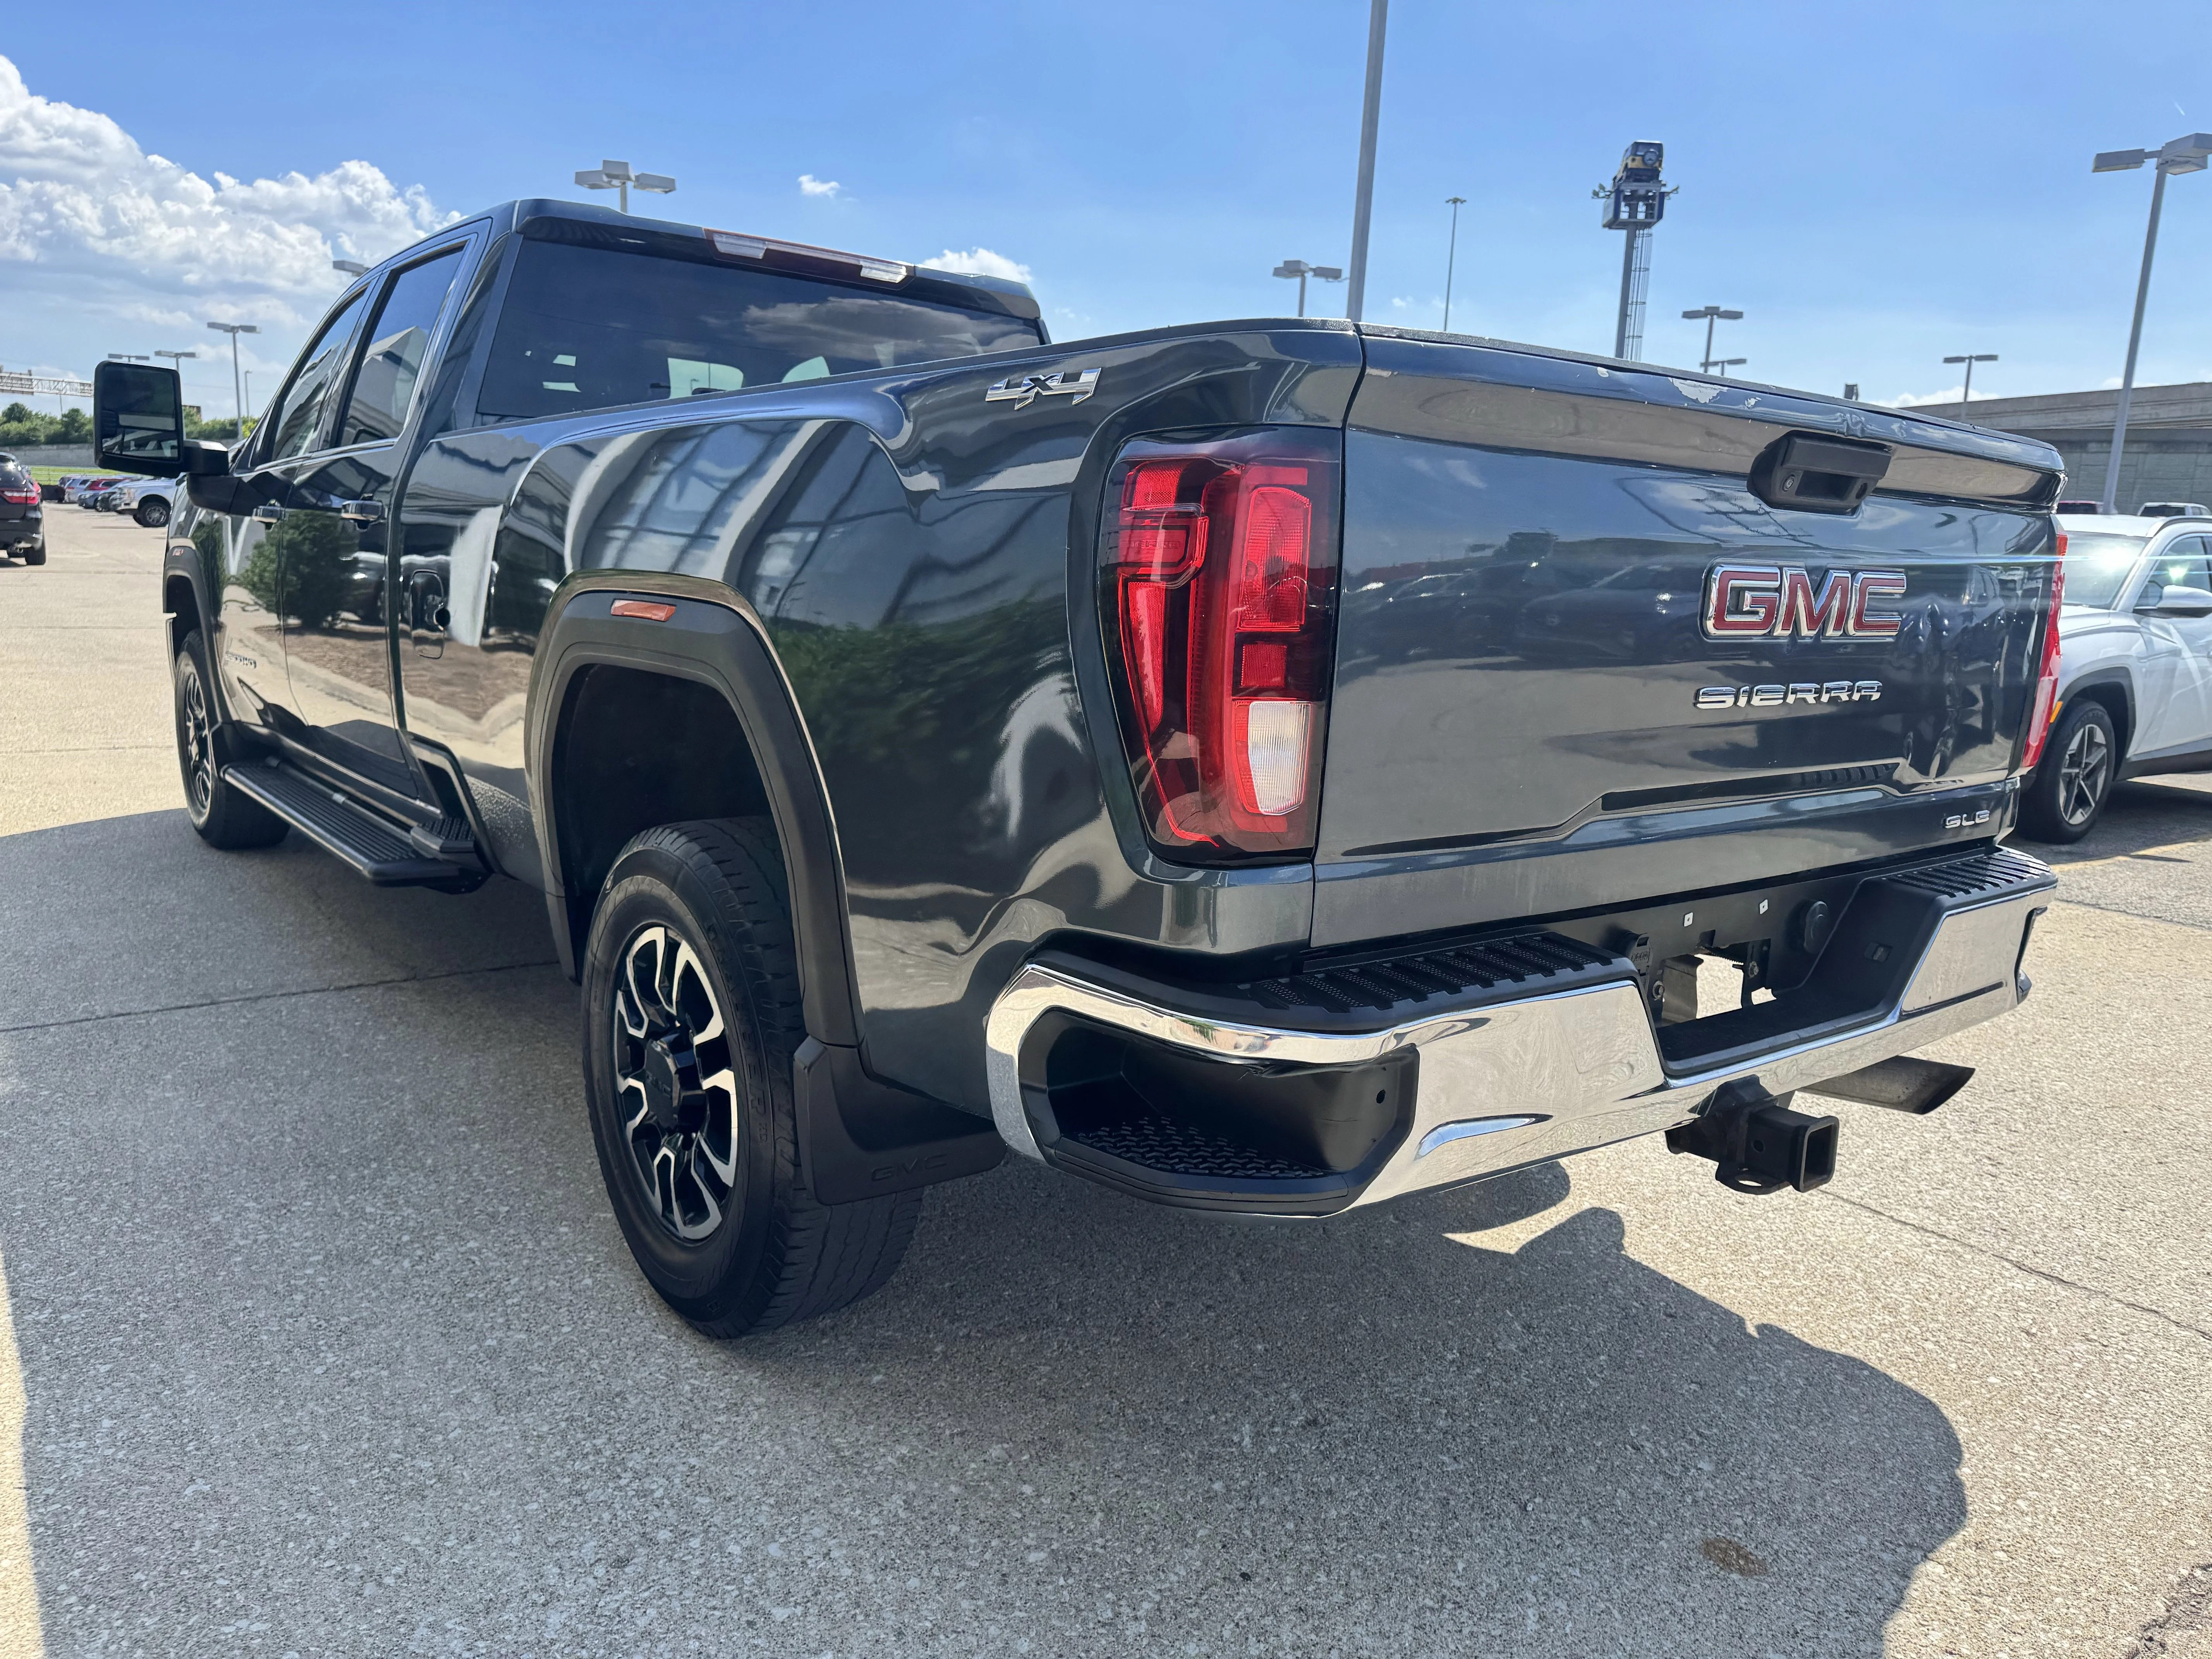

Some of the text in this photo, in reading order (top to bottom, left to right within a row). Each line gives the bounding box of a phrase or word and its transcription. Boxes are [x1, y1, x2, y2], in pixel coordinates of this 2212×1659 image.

[1706, 564, 1907, 637] GMC
[1694, 680, 1883, 709] SIERRA
[1945, 810, 1990, 829] SLE
[645, 1070, 671, 1098] GMC
[871, 1153, 947, 1182] GMC
